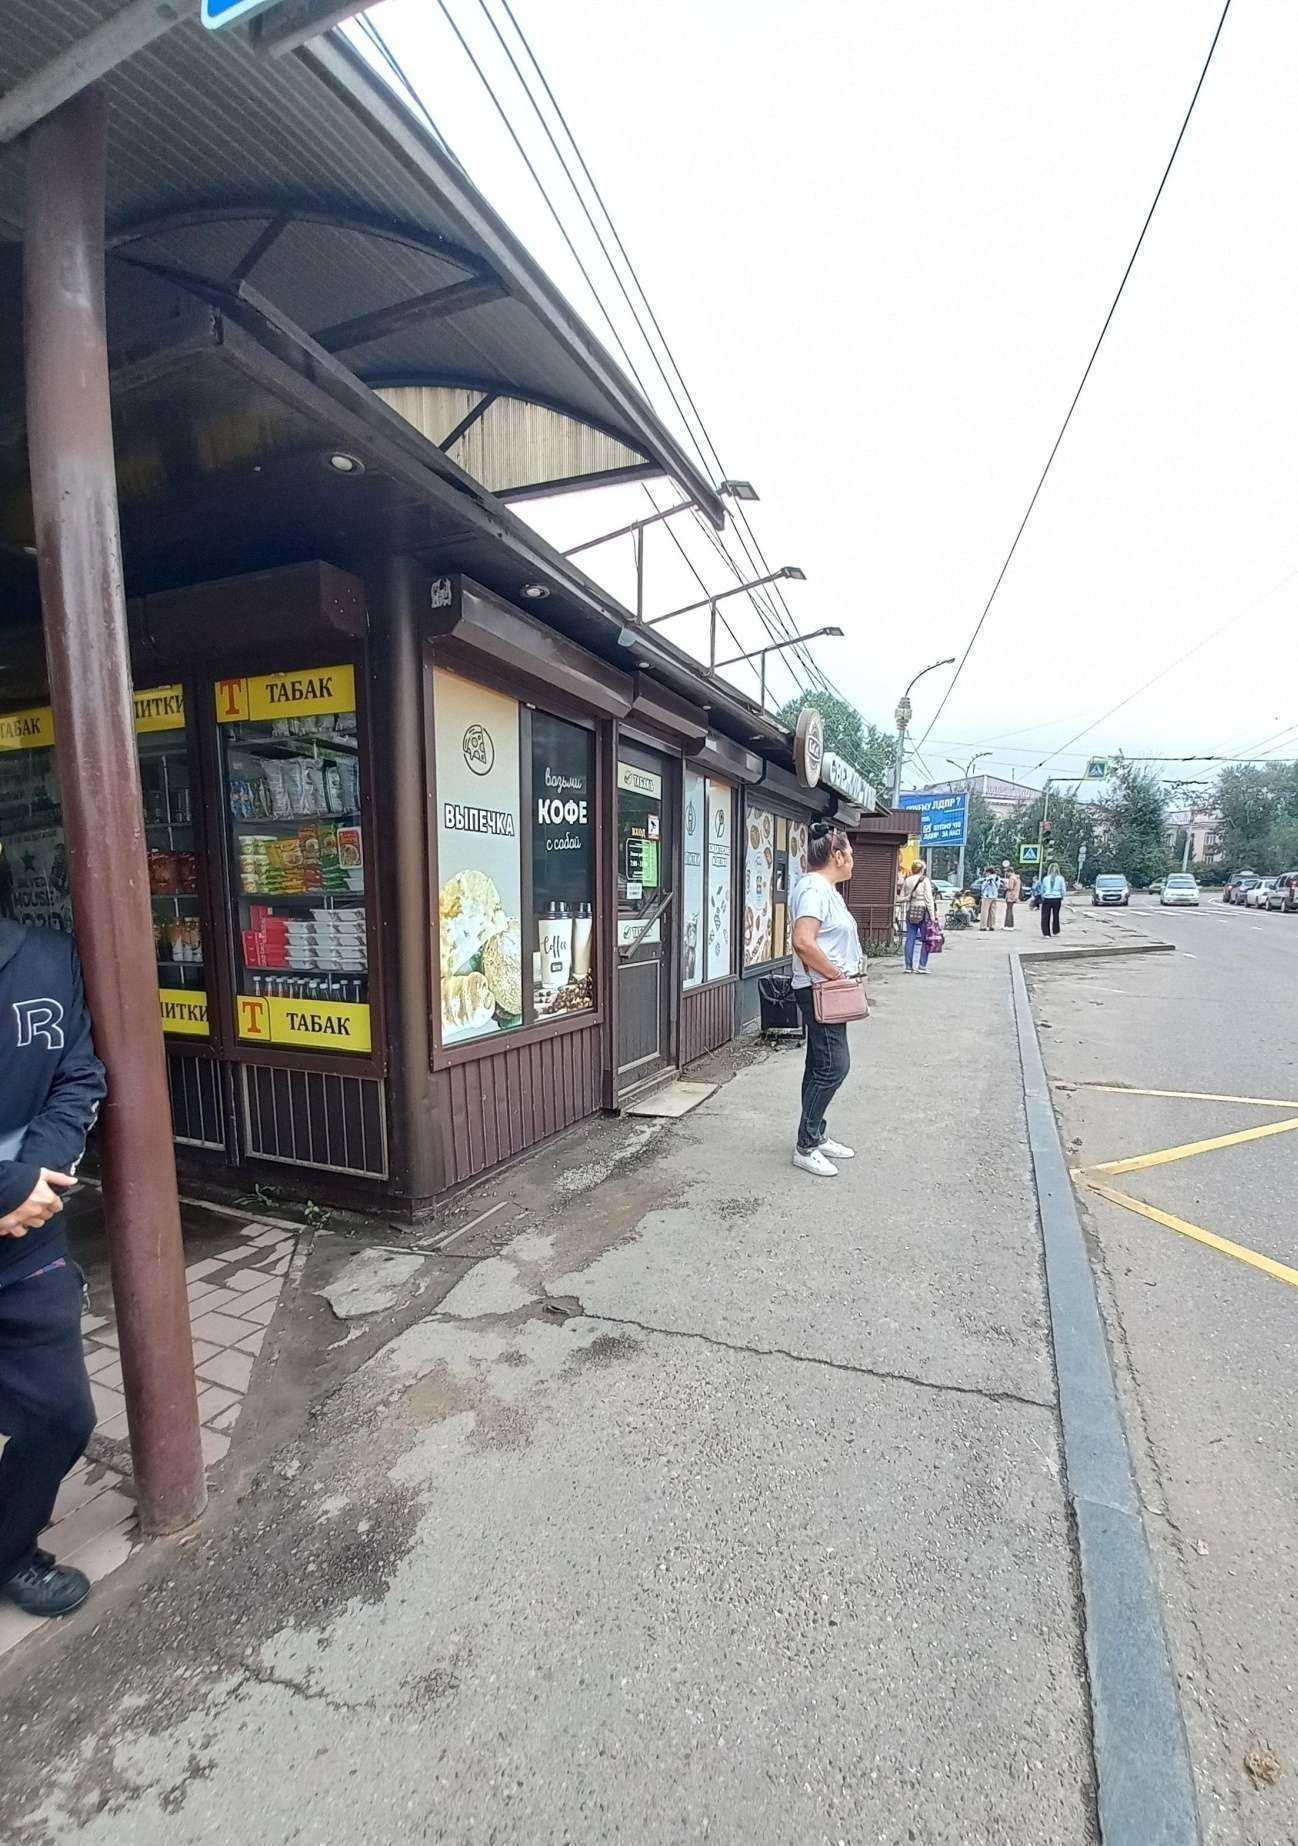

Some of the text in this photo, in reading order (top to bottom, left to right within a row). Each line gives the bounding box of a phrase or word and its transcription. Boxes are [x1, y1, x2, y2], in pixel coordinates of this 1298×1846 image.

[266, 676, 333, 704] ТАБАК
[0, 717, 41, 740] ТАБАК
[545, 767, 582, 793] возьми
[444, 802, 515, 837] ВЫПЕЧКА
[538, 798, 588, 825] КОФЕ
[553, 832, 581, 850] собой
[286, 1012, 351, 1036] ТАБАК
